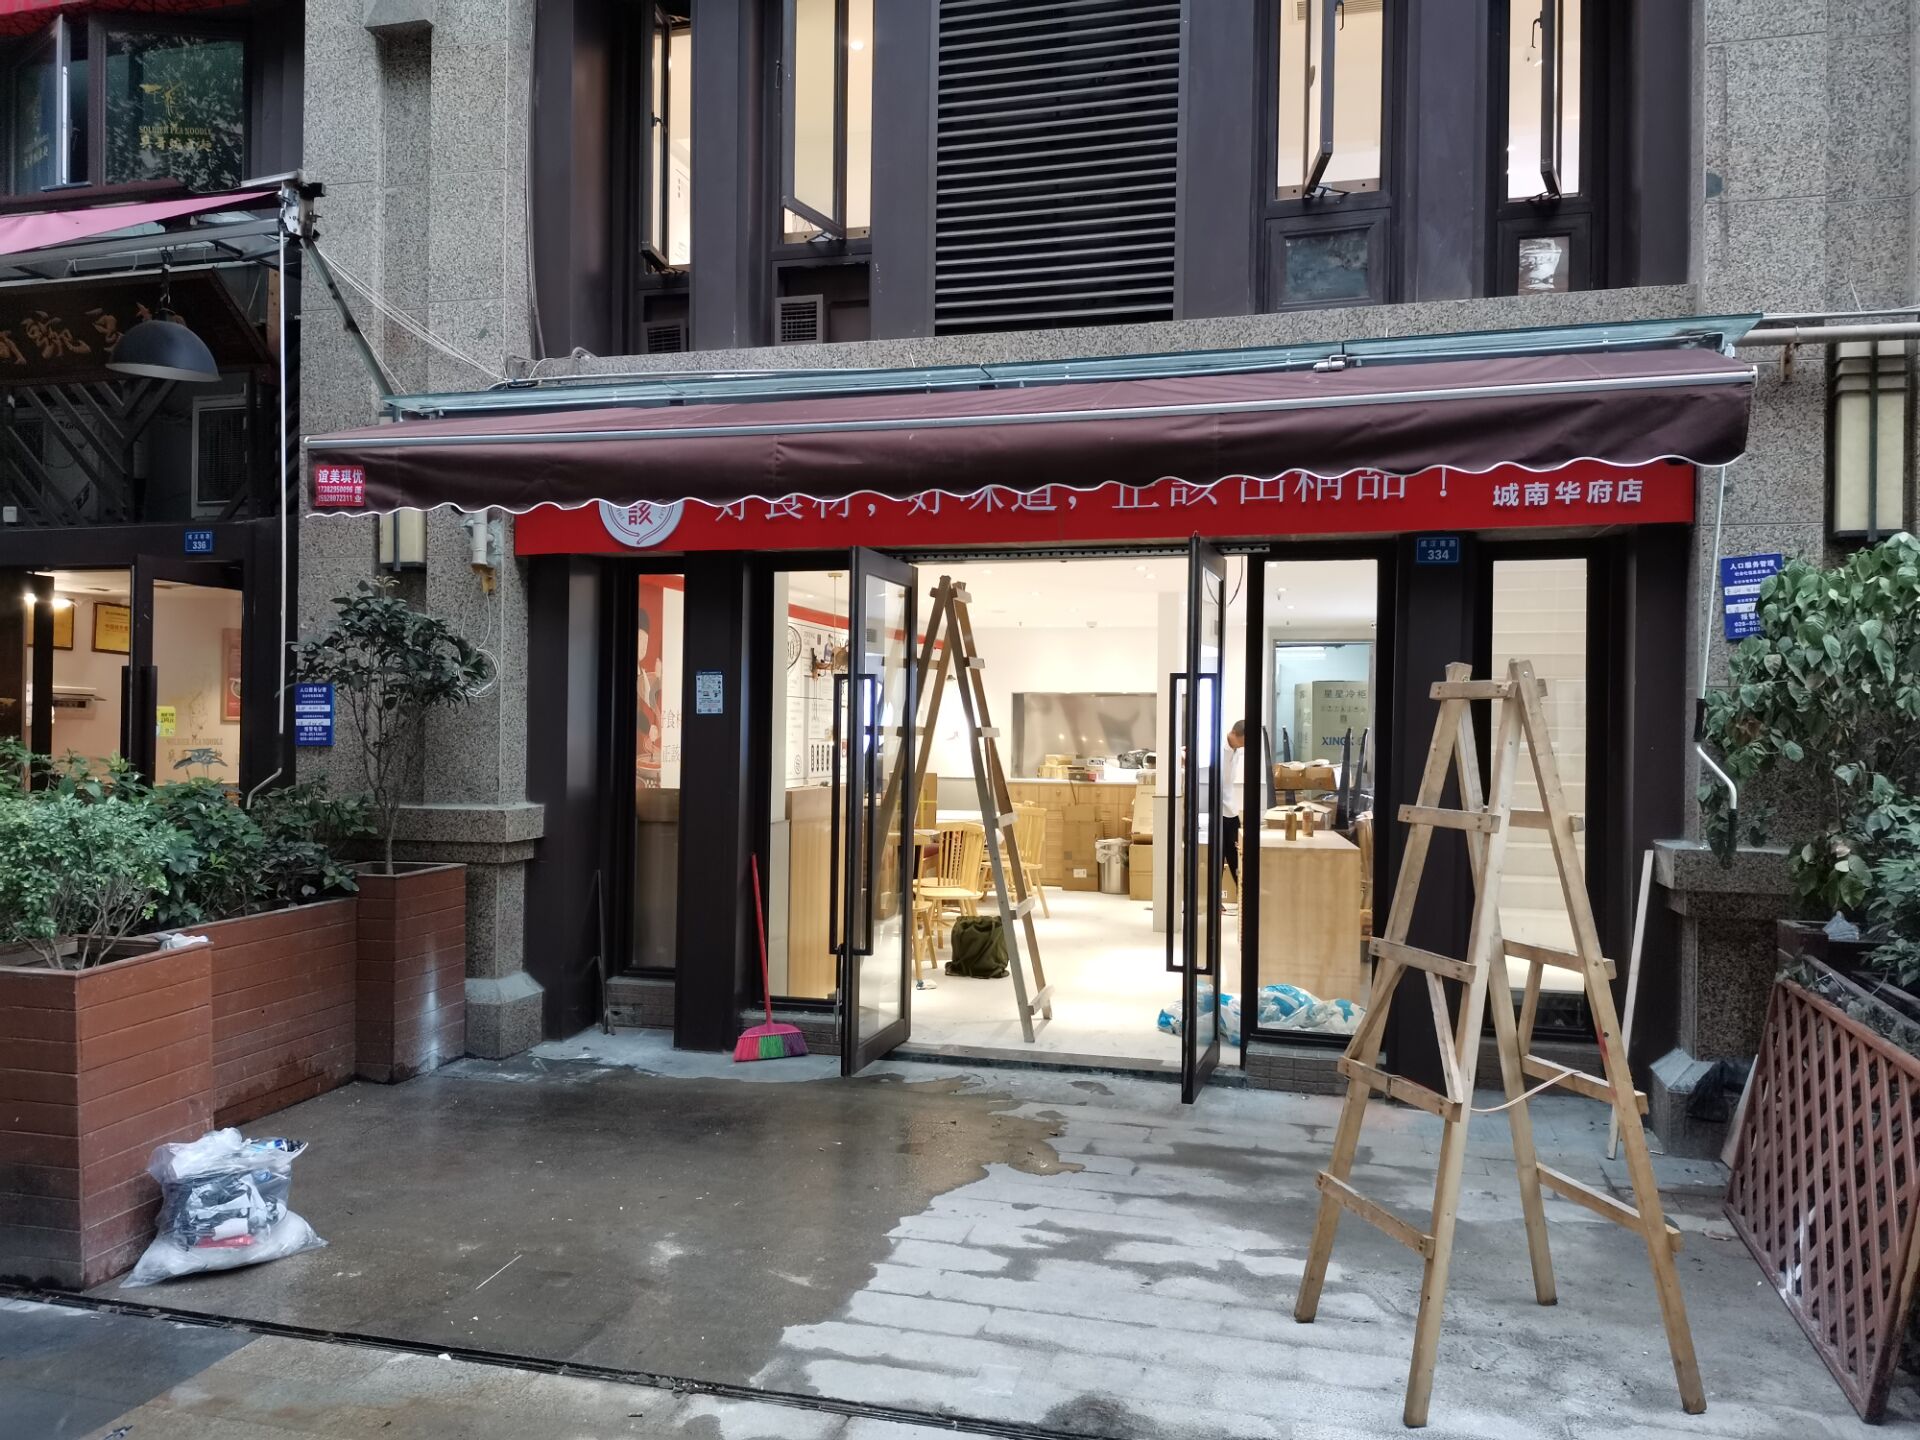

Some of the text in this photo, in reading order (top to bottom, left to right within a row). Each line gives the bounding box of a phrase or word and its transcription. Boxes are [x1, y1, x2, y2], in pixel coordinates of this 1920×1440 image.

[1493, 479, 1644, 507] 城南华府店
[192, 541, 207, 549] 336
[1427, 549, 1450, 560] 334
[1740, 612, 1760, 621] 报警
[1324, 689, 1367, 699] 星星冷柜
